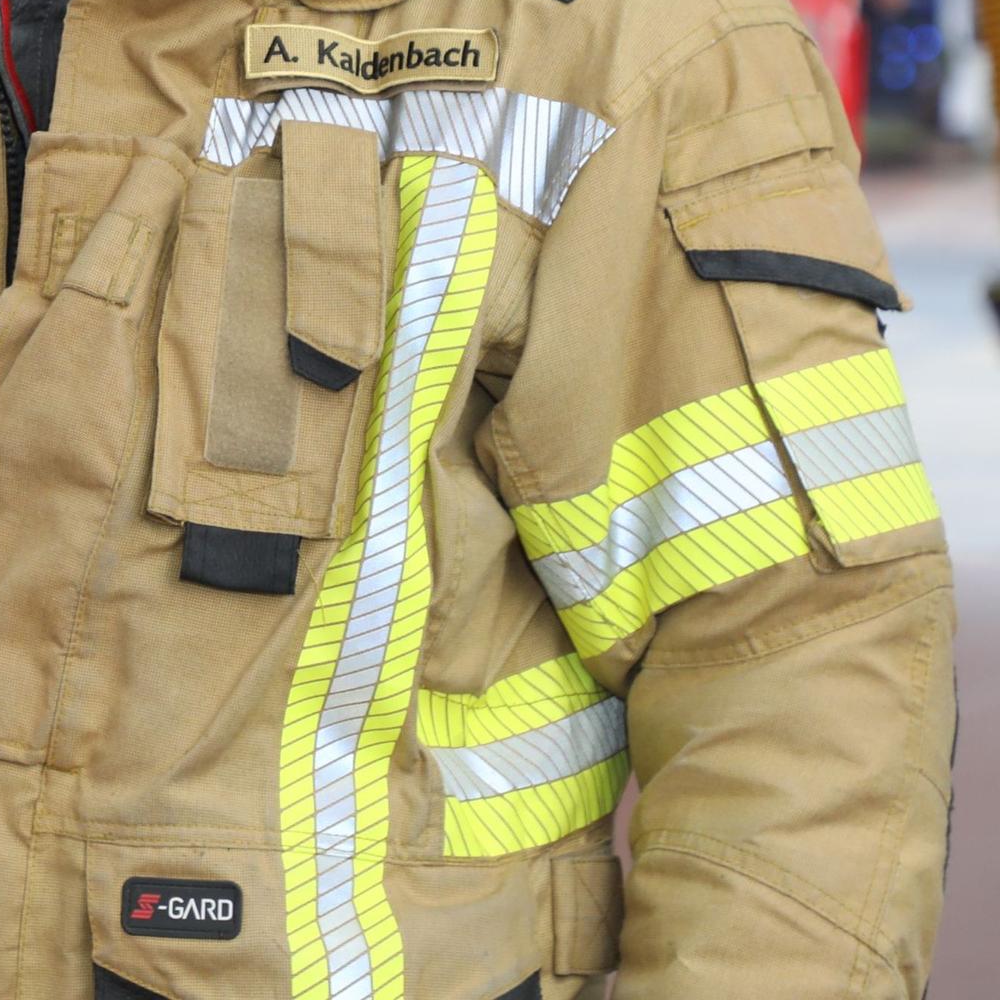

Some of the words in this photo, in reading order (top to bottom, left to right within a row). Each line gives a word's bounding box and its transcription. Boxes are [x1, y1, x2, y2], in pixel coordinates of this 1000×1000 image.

[263, 35, 299, 64] A.
[316, 38, 481, 81] Kaldenbach
[130, 893, 234, 921] S-GARD
